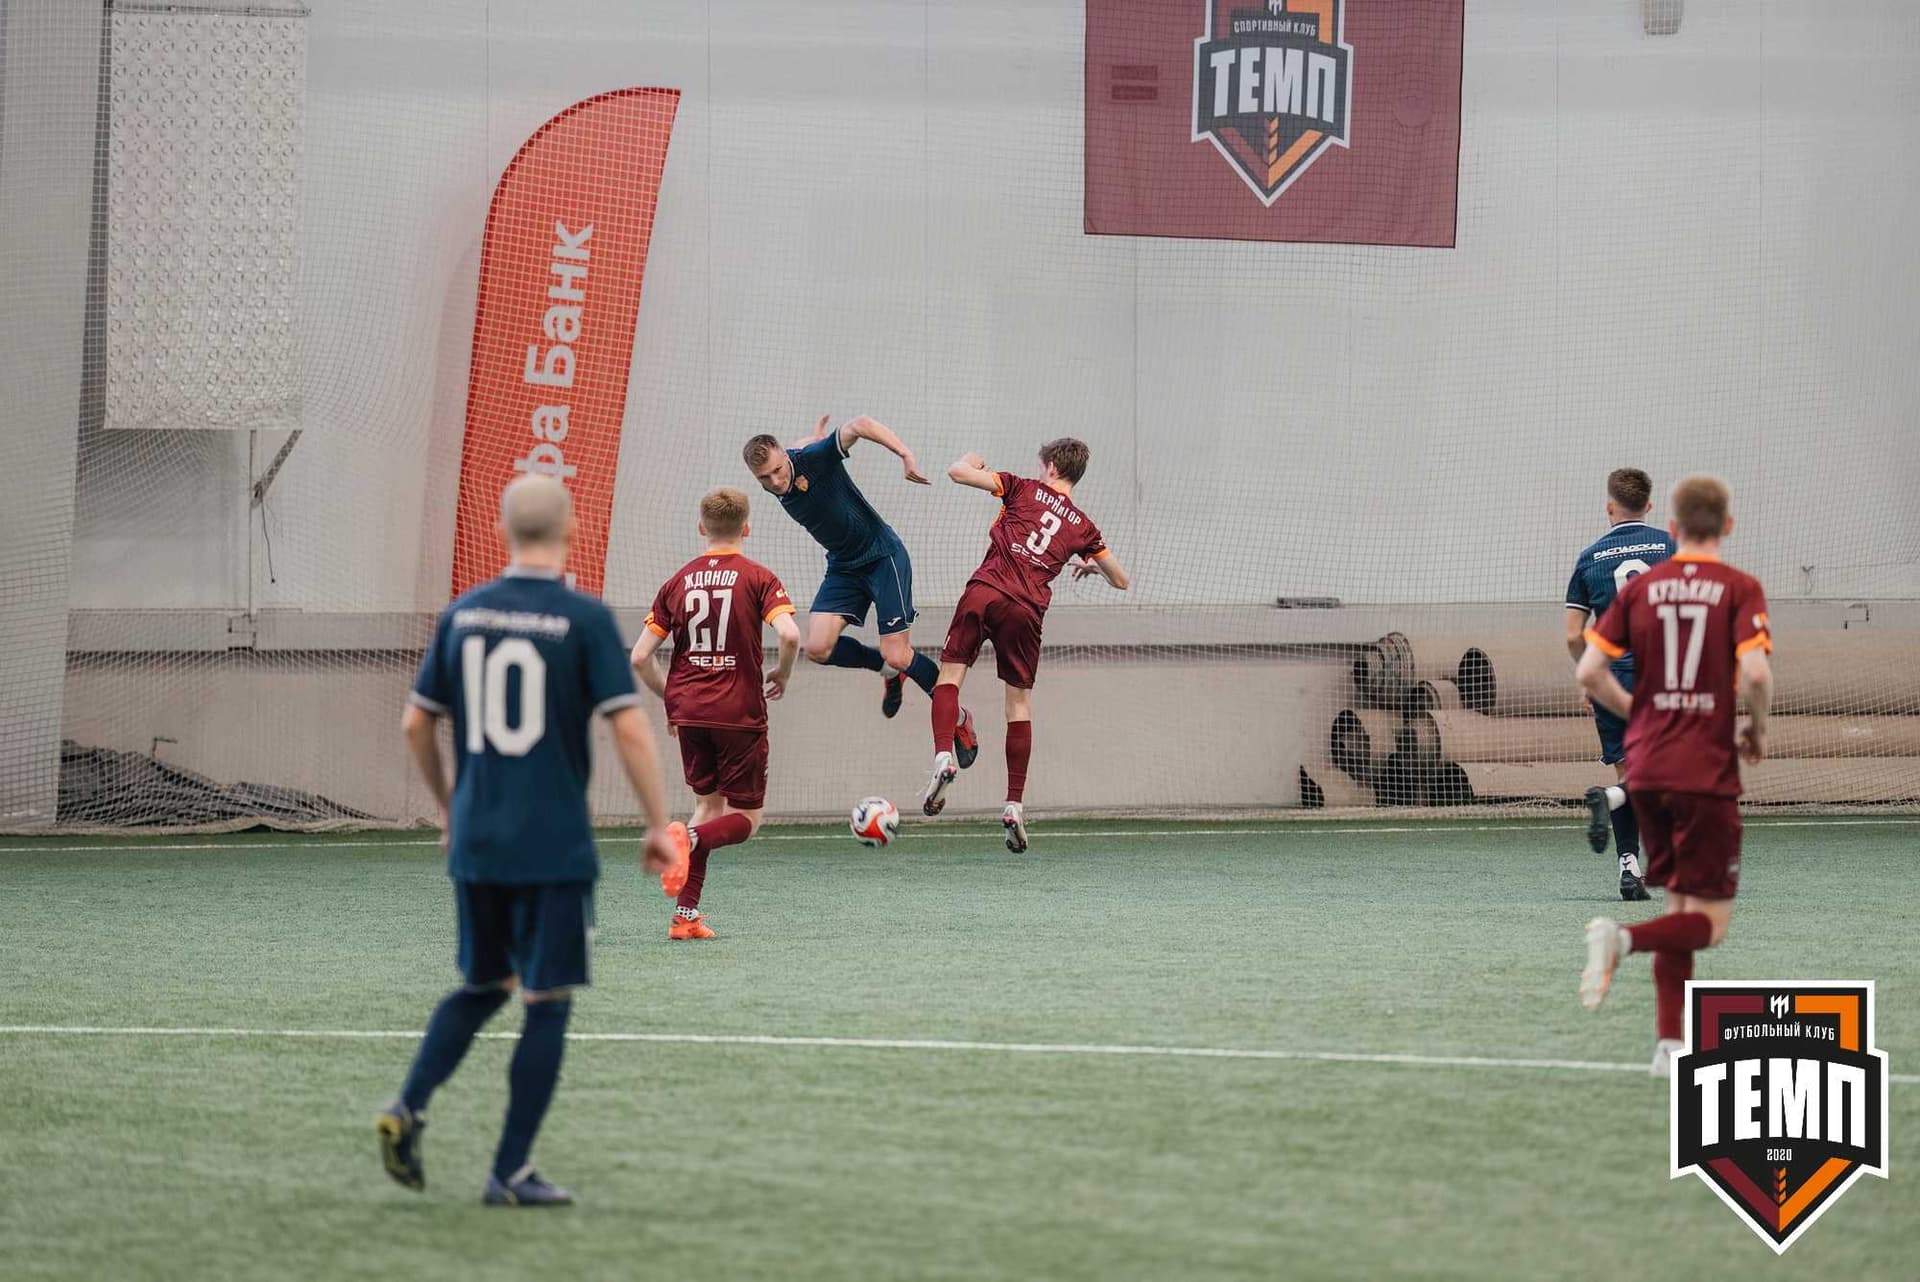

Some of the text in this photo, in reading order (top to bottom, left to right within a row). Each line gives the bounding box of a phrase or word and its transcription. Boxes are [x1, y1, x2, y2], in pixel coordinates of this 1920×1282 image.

[1234, 19, 1317, 37] СПОРТИВНЫЙ КЛУБ
[1210, 46, 1337, 123] ТЕМП
[526, 221, 593, 388] Банк
[1026, 510, 1062, 556] 3
[684, 570, 738, 590] ЖДАНОВ
[685, 588, 733, 652] 27
[1657, 604, 1708, 691] 17
[688, 655, 736, 667] SEUS
[462, 635, 547, 757] 10
[1653, 693, 1715, 710] SEUS
